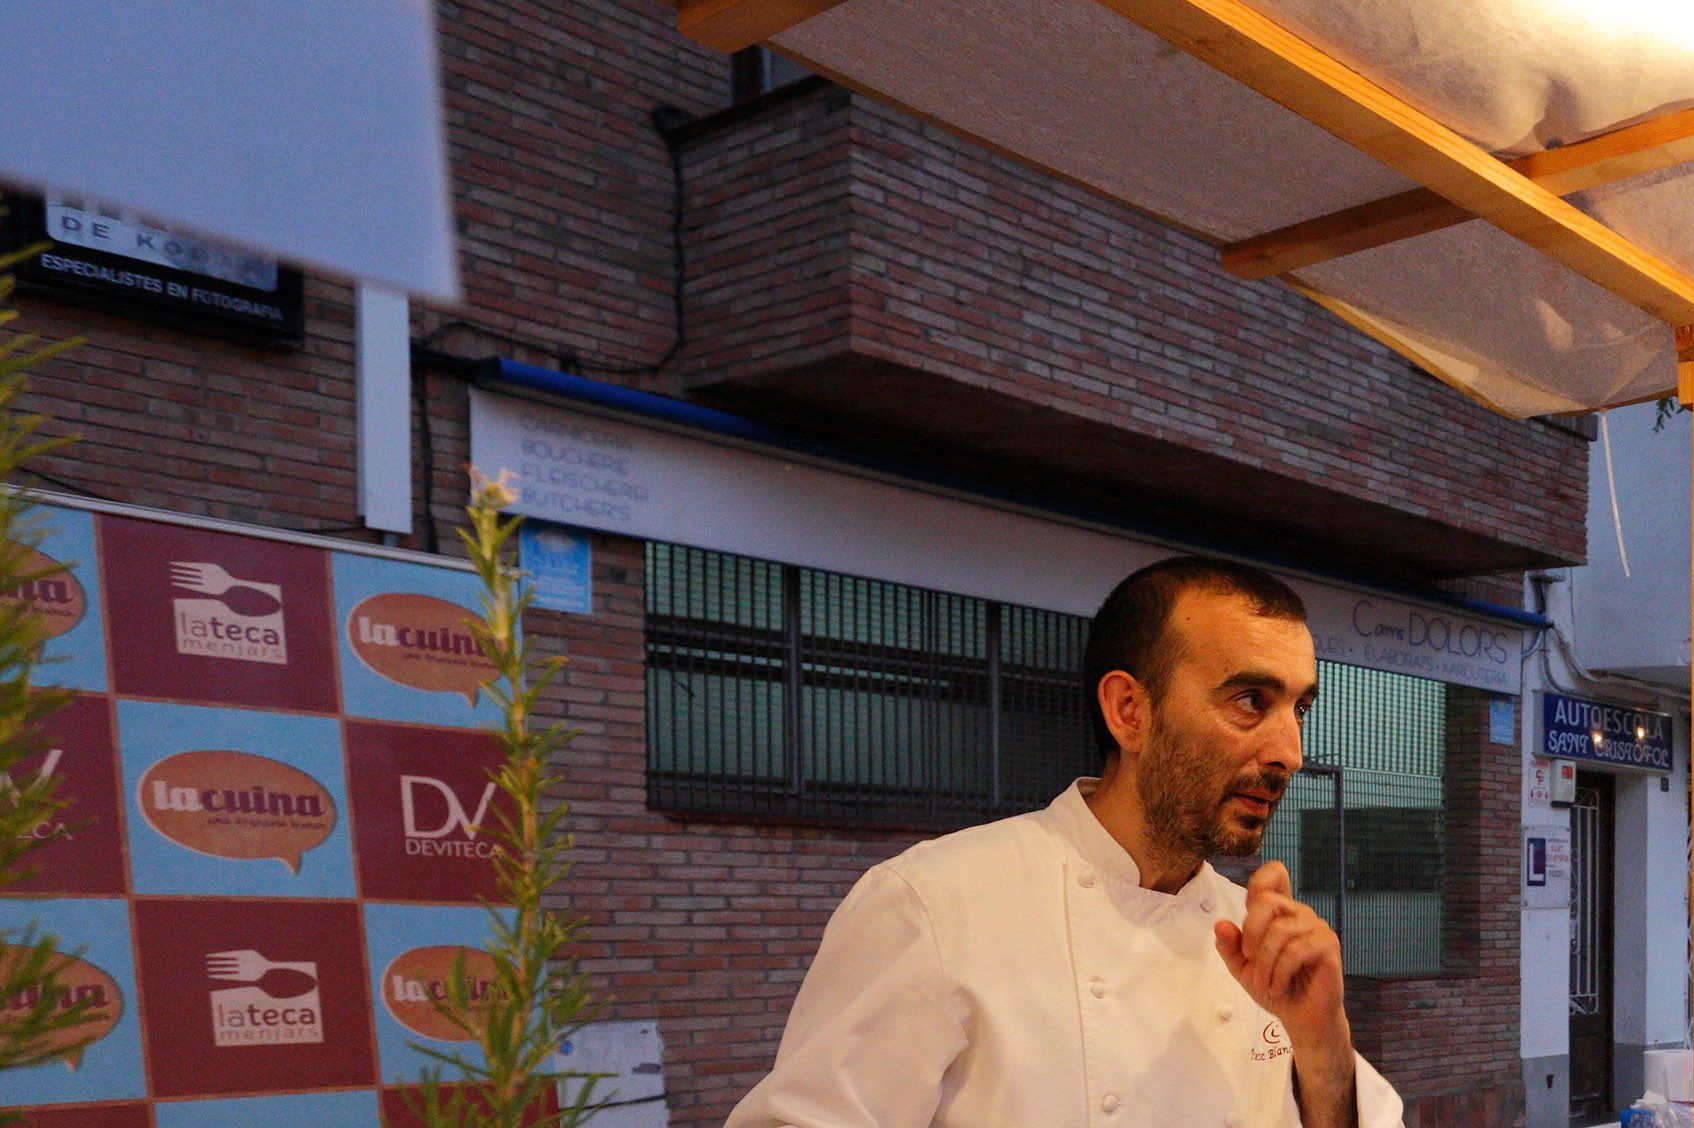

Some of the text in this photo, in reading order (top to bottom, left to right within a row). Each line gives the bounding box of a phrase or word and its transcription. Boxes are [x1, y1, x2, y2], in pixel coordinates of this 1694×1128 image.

[166, 281, 188, 299] EN
[1408, 612, 1508, 664] DOLORS
[1554, 699, 1664, 741] AUTOESCOLA
[1549, 729, 1590, 755] SANT
